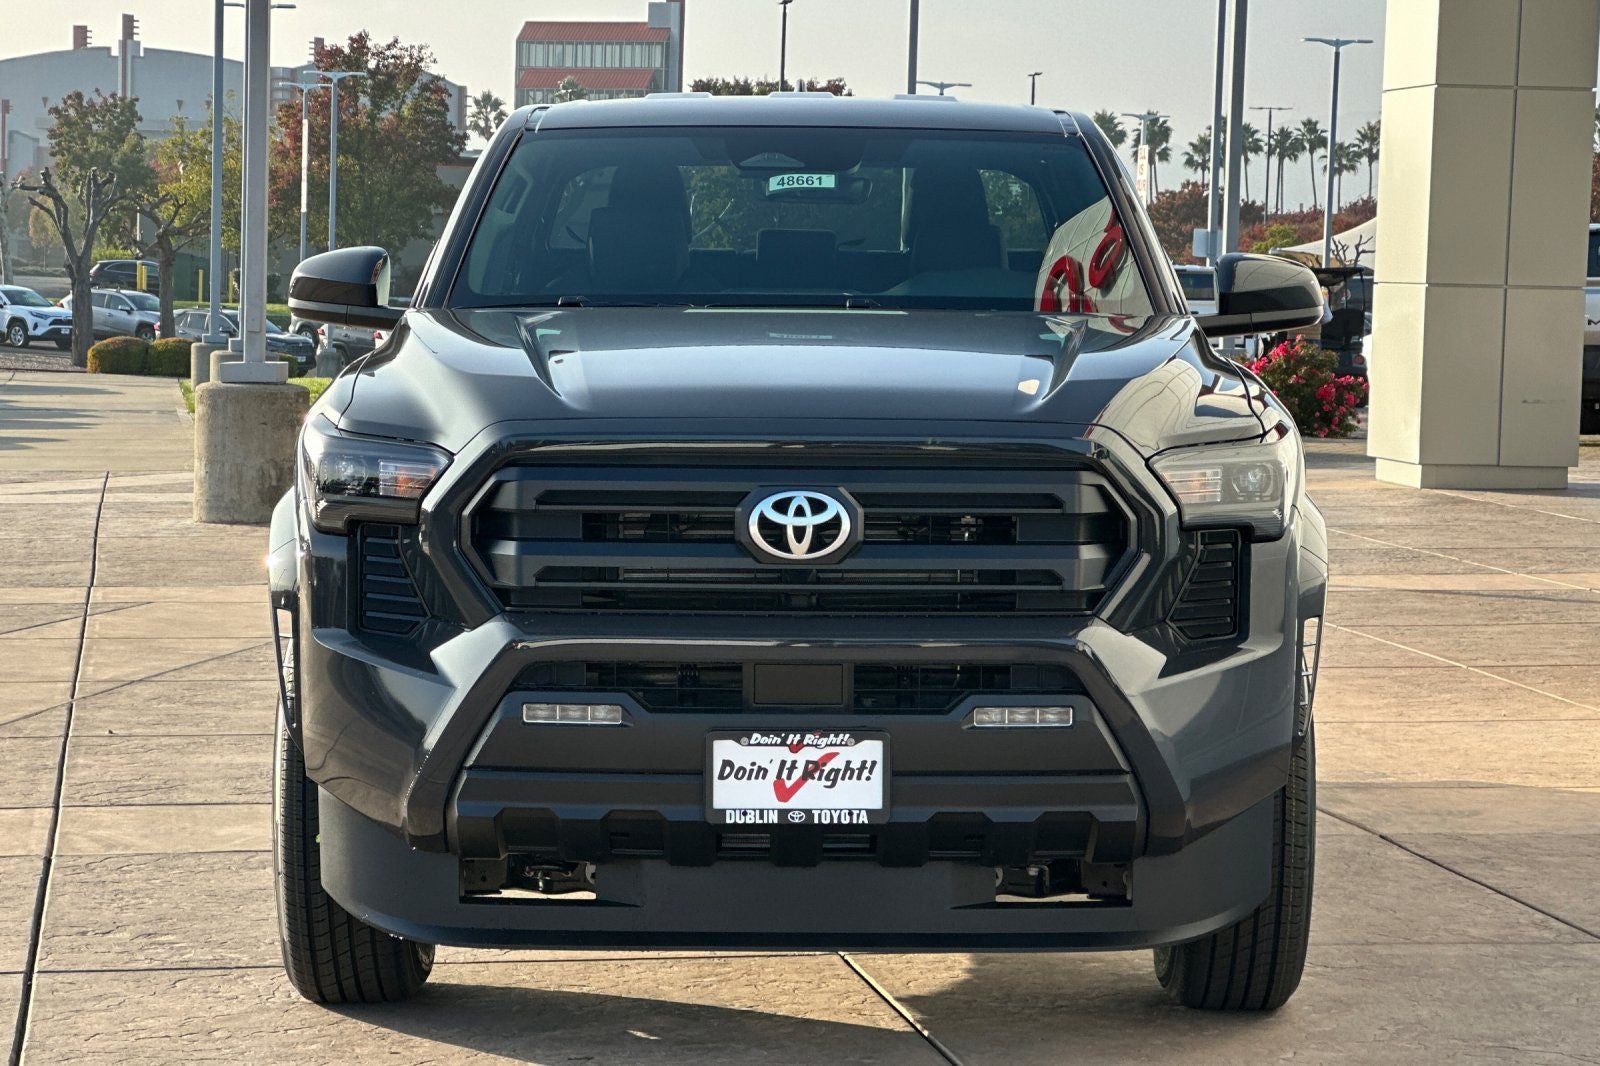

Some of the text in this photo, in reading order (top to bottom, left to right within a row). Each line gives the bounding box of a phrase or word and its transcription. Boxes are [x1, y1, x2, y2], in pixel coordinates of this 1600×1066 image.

[776, 175, 823, 187] 48661
[749, 732, 850, 748] Doin' It Right!
[717, 759, 878, 788] Doin' It Right!
[725, 809, 869, 824] DUBLIN TOYOTA
